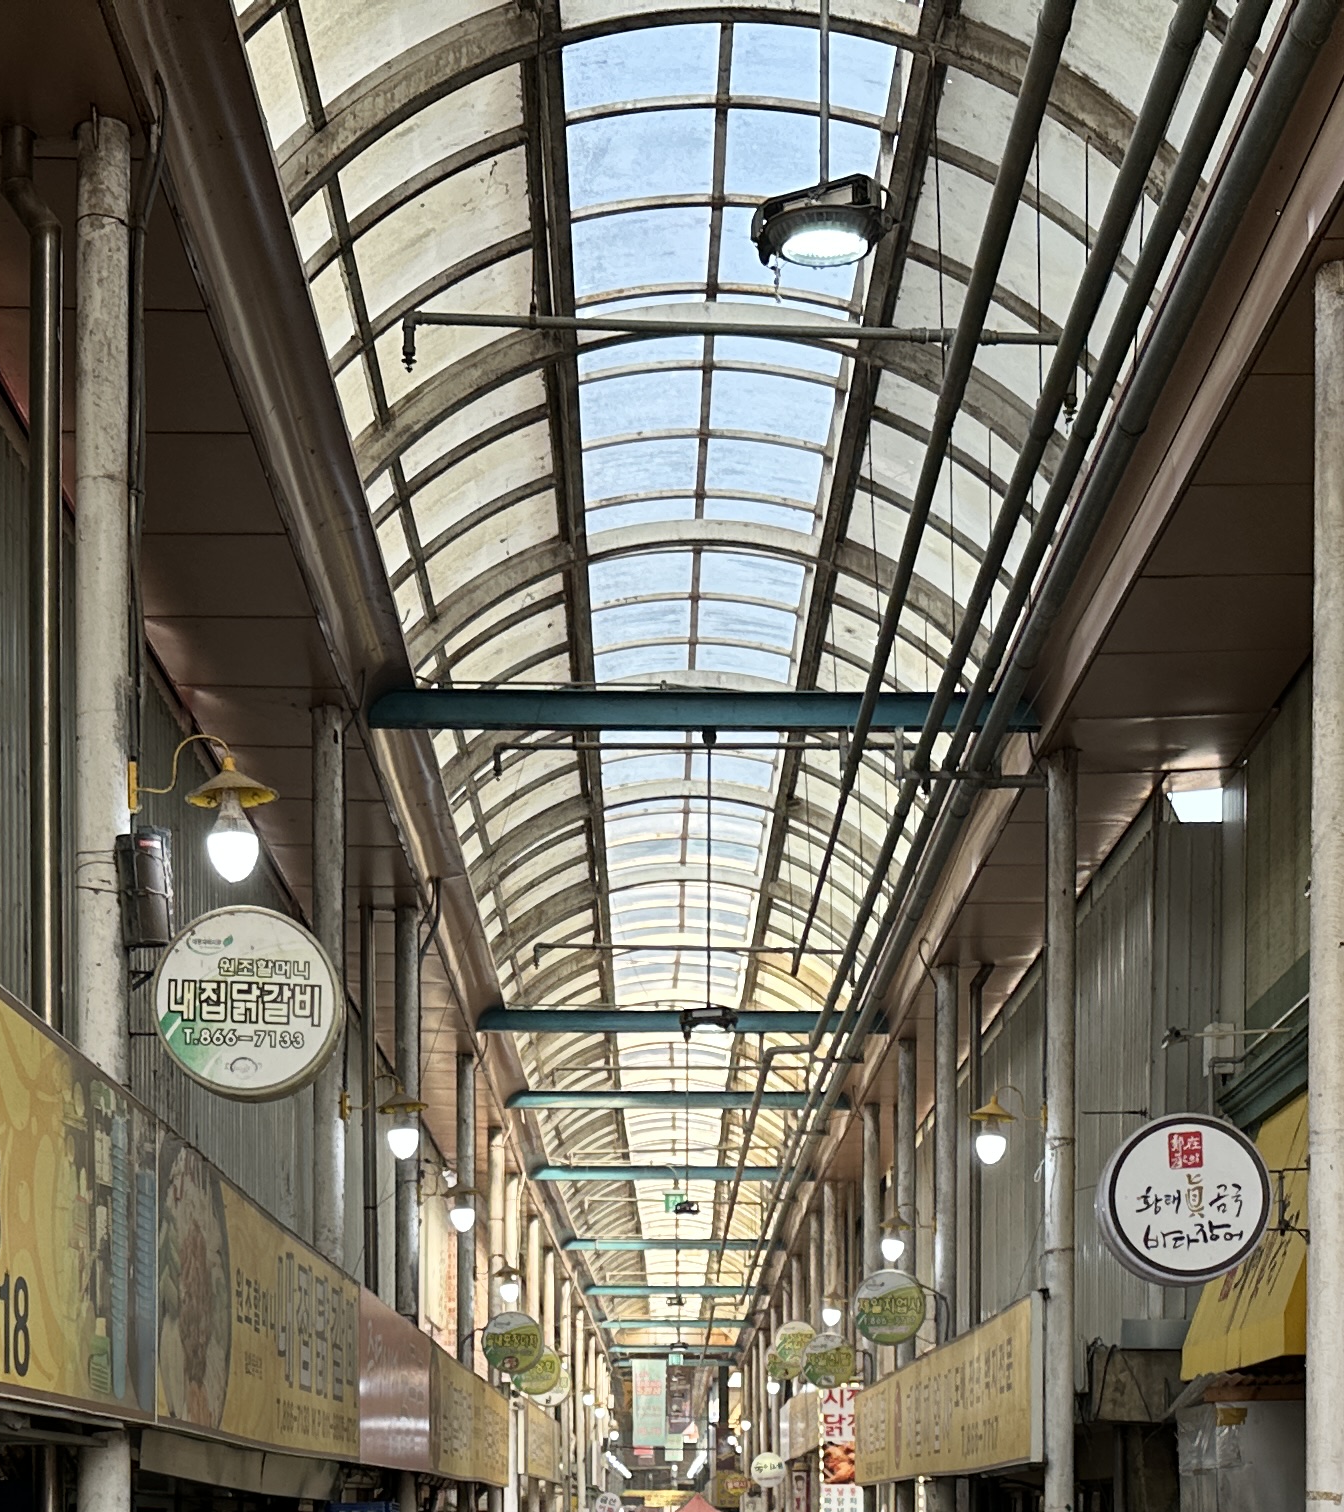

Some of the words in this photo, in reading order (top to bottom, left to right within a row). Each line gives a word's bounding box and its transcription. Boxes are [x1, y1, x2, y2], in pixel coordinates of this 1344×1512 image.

[218, 957, 311, 980] 원조할머니
[168, 978, 322, 1028] 내집닭갈비
[182, 1027, 305, 1050] T.866-7133
